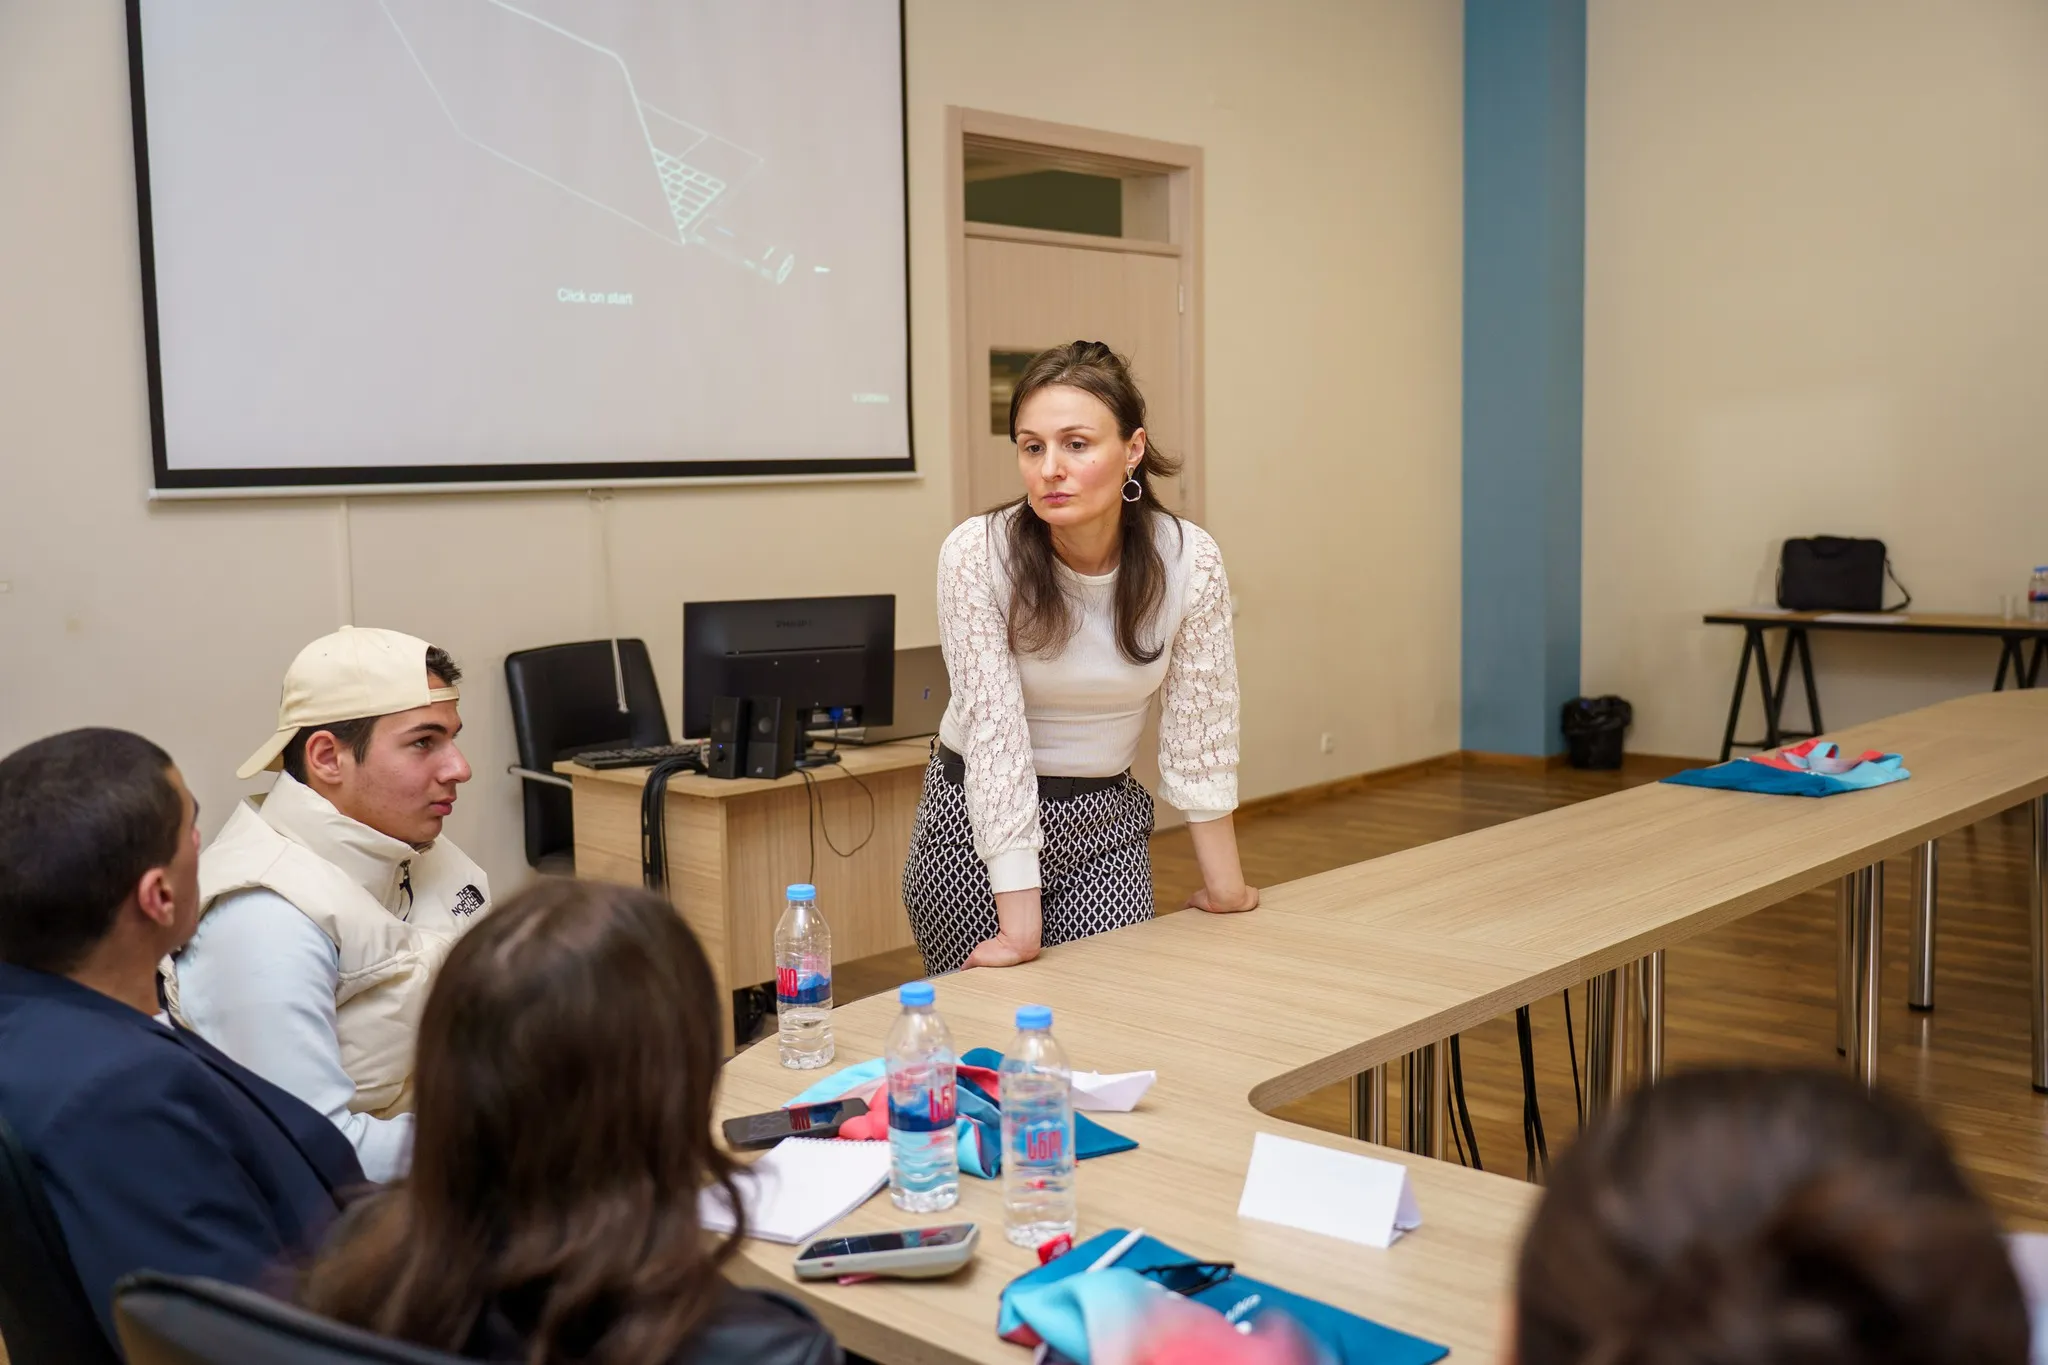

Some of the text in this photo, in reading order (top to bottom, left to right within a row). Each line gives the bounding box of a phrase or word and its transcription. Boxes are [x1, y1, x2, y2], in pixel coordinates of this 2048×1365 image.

[556, 287, 634, 306] Click on start
[456, 887, 470, 901] THE
[451, 892, 477, 917] NORTH
[463, 901, 481, 918] FACE
